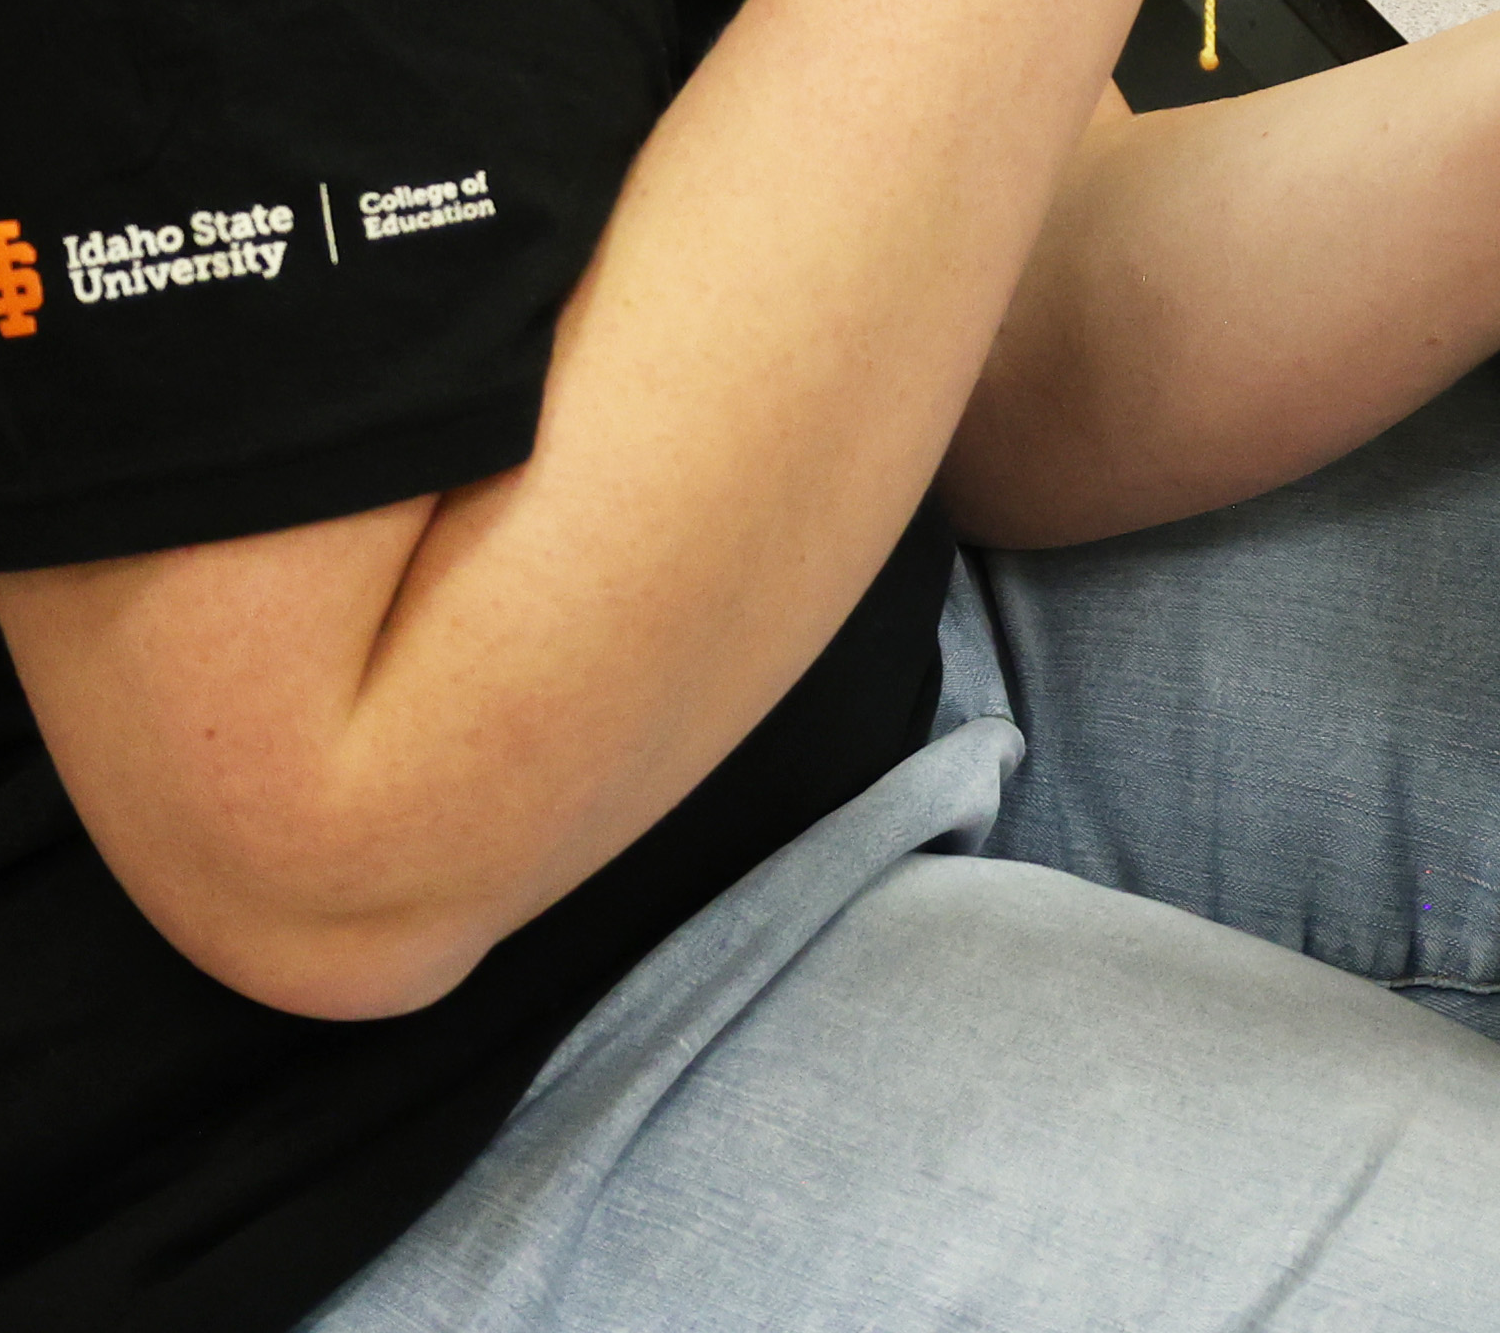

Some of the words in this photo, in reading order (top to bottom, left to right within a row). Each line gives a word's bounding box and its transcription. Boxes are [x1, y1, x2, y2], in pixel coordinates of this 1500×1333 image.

[360, 177, 458, 216] College
[461, 170, 488, 195] of
[363, 194, 496, 239] Education
[65, 221, 183, 269] Idaho
[190, 201, 293, 245] State
[69, 238, 287, 303] University
